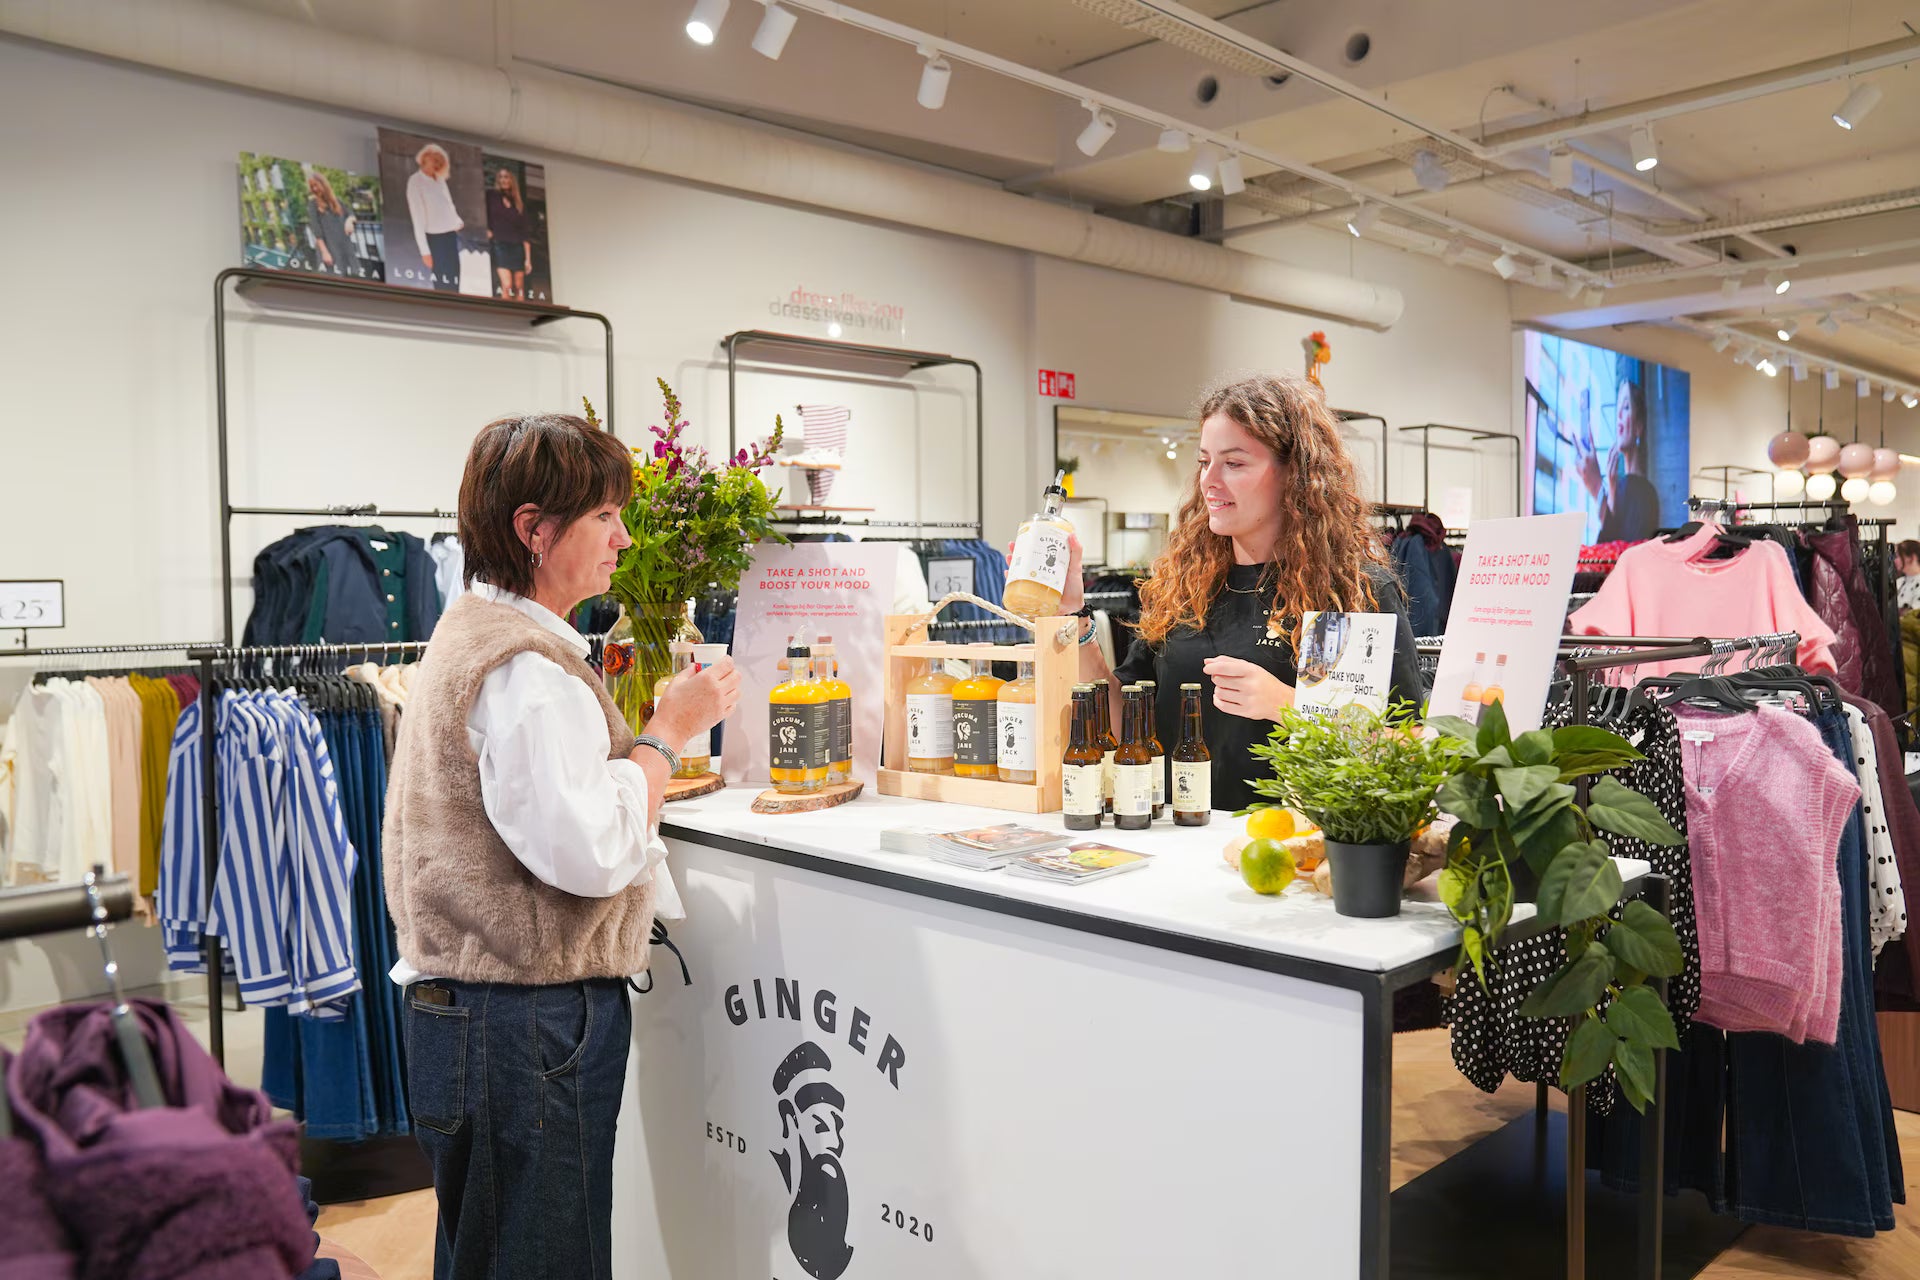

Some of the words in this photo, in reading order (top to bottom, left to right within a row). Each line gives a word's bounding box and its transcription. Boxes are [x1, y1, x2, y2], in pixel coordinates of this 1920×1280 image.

[277, 256, 380, 279] LOLALIZA
[393, 267, 459, 284] LOLALI
[496, 286, 546, 300] ALIZA
[1040, 536, 1066, 551] GINGER
[1477, 555, 1498, 567] TAKE
[1499, 556, 1505, 566] A
[1505, 554, 1529, 567] SHOT
[1531, 553, 1550, 566] AND
[767, 568, 794, 577] TAKE
[797, 568, 804, 577] A
[808, 568, 838, 577] SHOT
[841, 568, 866, 577] AND
[1038, 565, 1056, 575] JACK
[759, 580, 797, 590] BOOST
[800, 580, 831, 590] YOUR
[834, 580, 870, 590] MOOD
[1470, 573, 1497, 585] BOOST
[1497, 573, 1520, 585] YOUR
[1521, 573, 1550, 586] MOOD
[1256, 639, 1281, 647] JACK
[1328, 671, 1344, 682] TAKE
[1346, 672, 1365, 683] YOUR
[1320, 706, 1339, 718] YOUR
[772, 716, 806, 727] CURCUMA
[724, 977, 906, 1091] GINGER
[706, 1121, 747, 1154] ESTD
[881, 1203, 934, 1243] 2020
